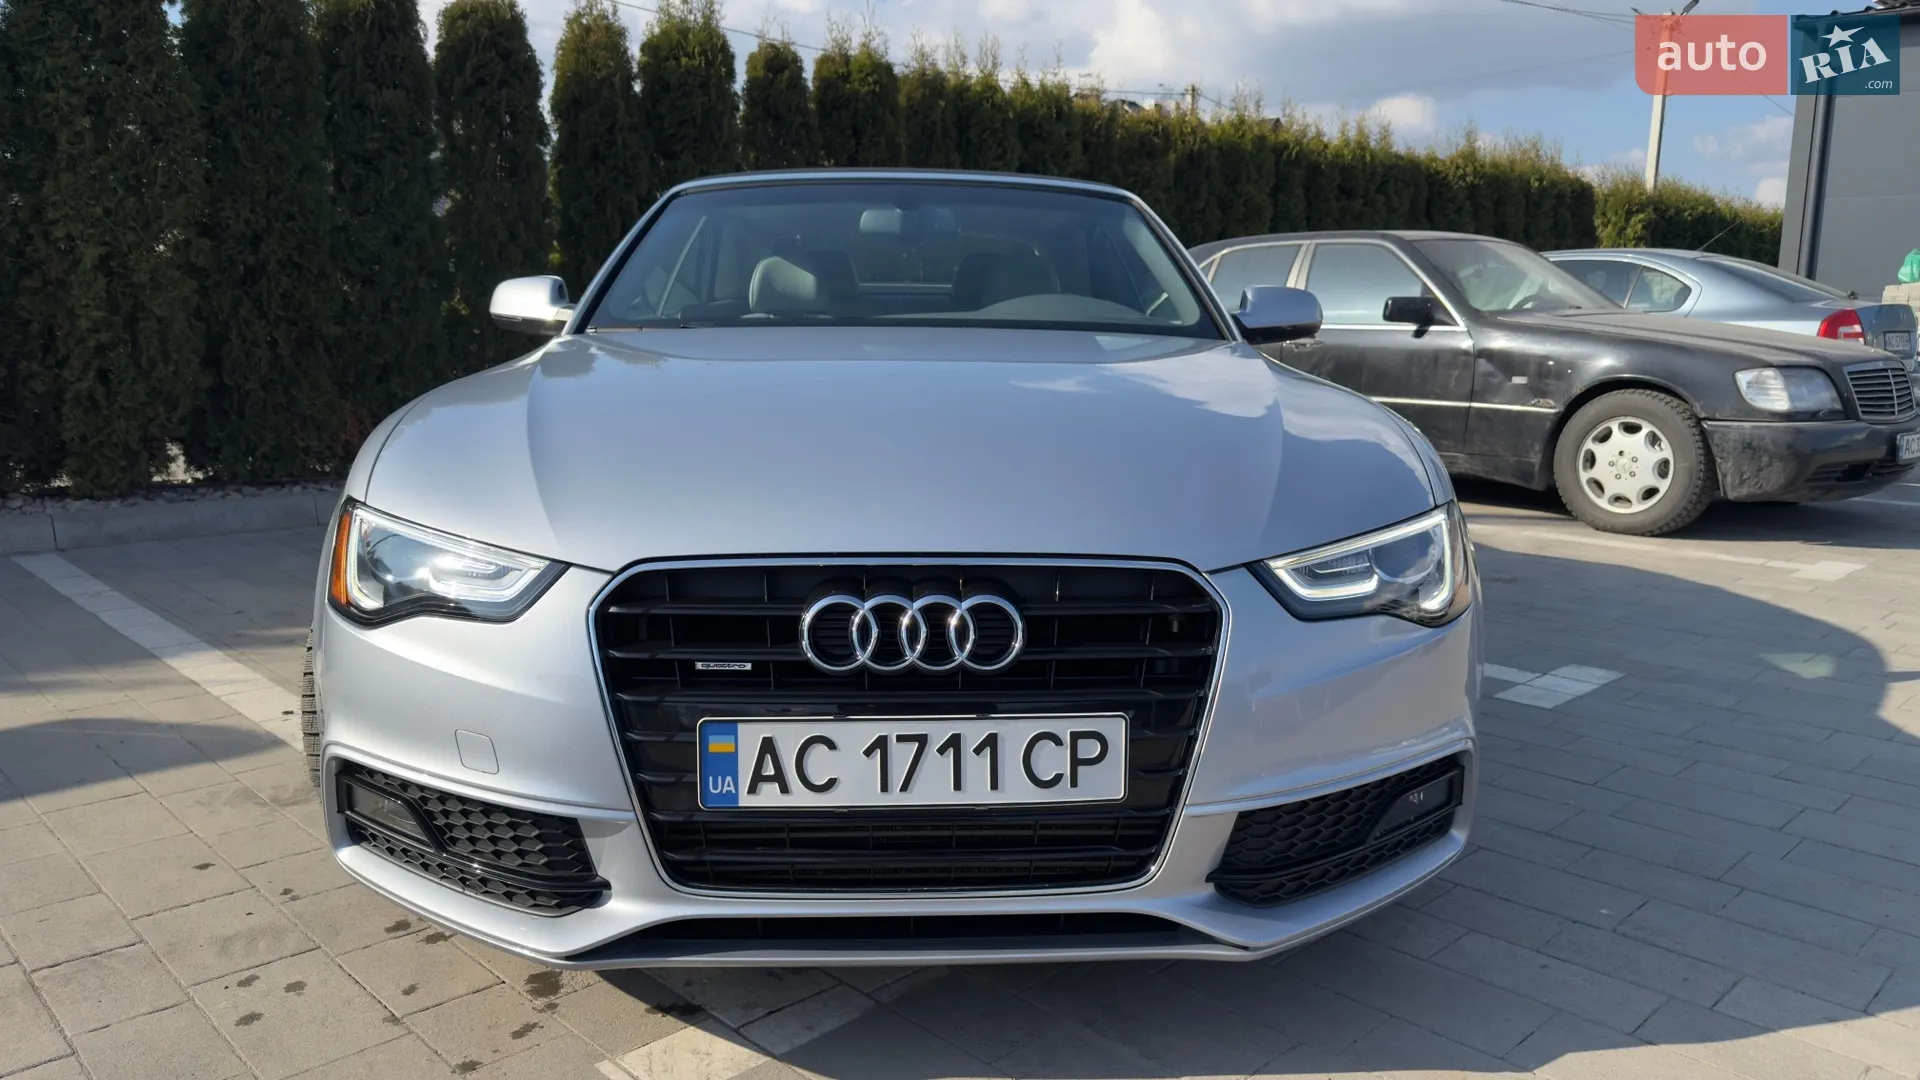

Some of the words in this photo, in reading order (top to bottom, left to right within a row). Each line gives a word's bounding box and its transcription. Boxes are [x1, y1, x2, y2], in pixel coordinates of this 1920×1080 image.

[708, 776, 736, 794] UA
[746, 734, 838, 795] AC
[862, 732, 999, 793] 1711
[1021, 730, 1109, 789] CP
